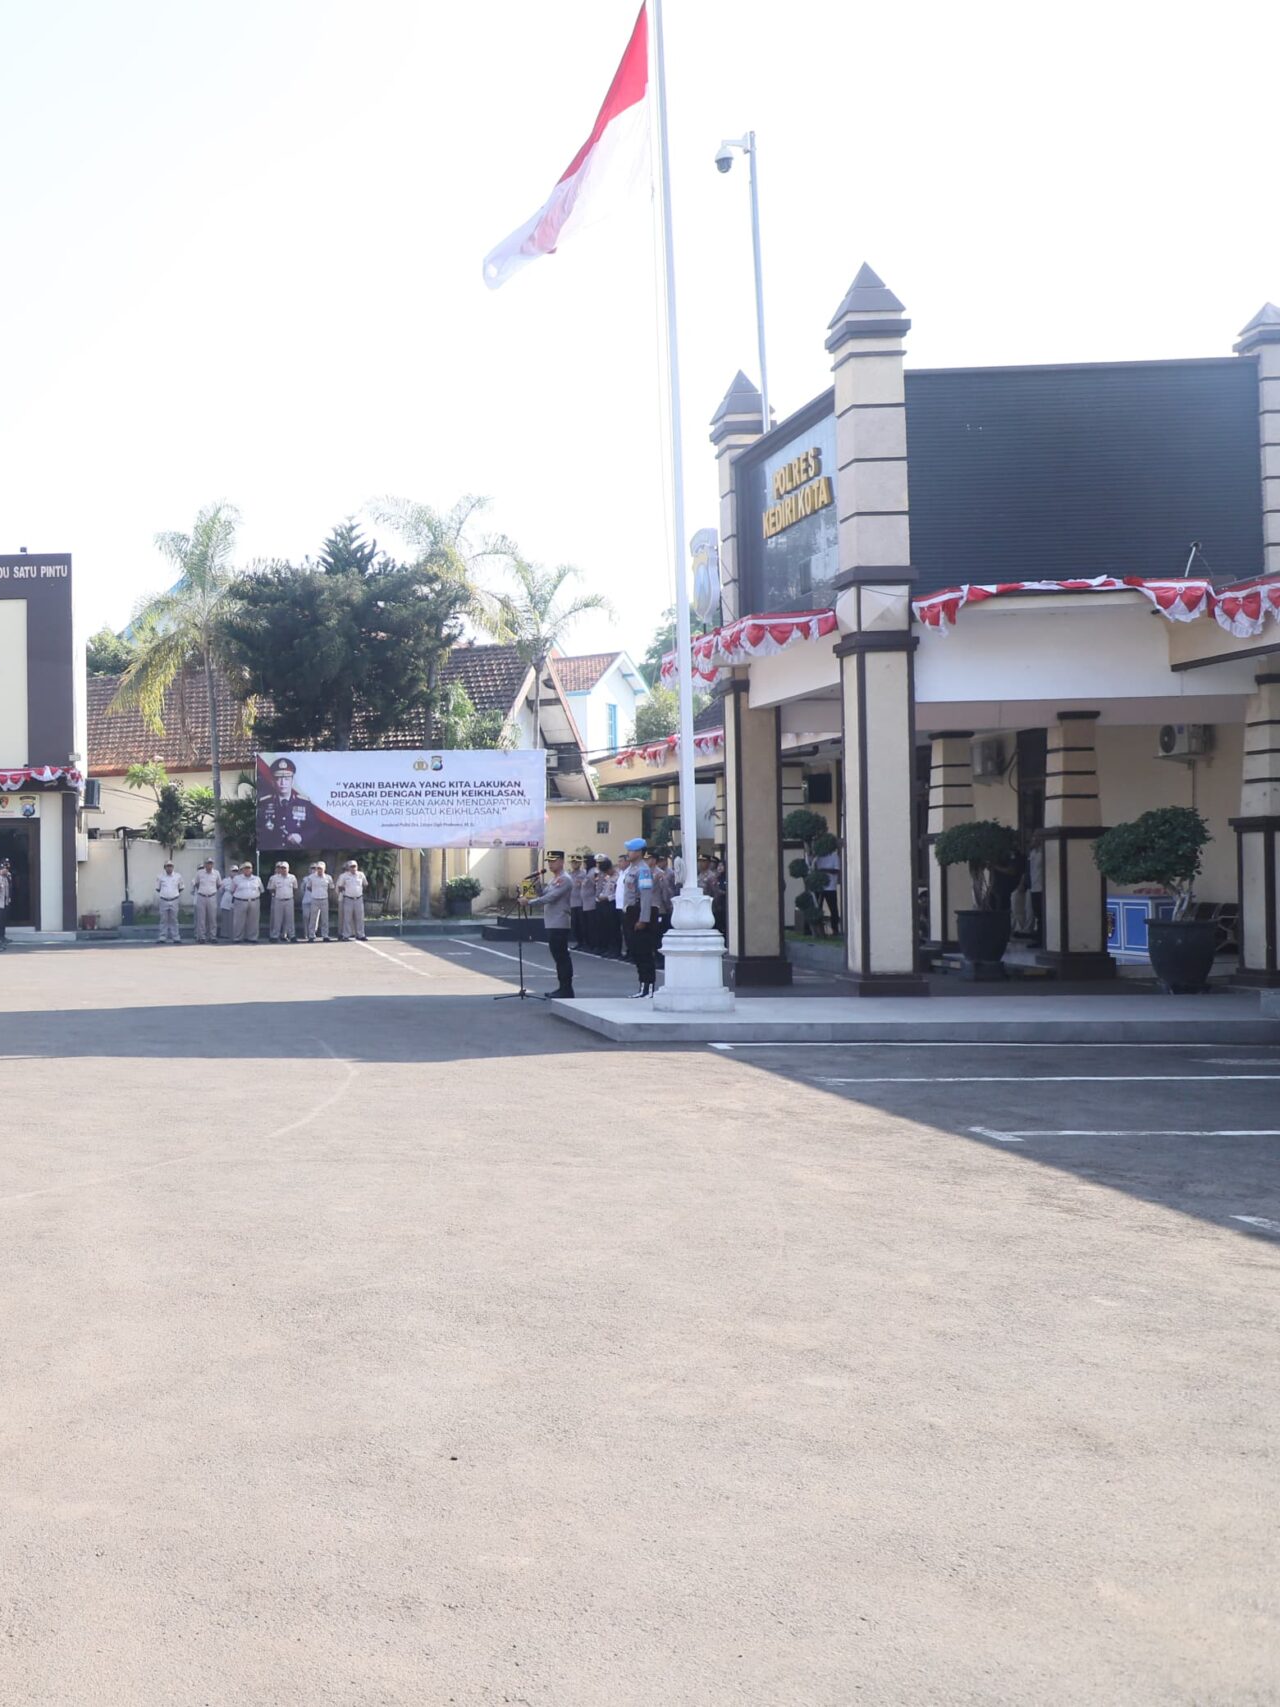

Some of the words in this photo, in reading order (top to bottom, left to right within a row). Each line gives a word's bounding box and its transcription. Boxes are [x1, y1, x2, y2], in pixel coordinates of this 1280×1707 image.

[773, 447, 820, 499] POLRES
[762, 492, 796, 539] KEDIRI
[797, 477, 832, 517] KOTA
[13, 565, 37, 579] SATU
[40, 564, 68, 578] PINTU
[342, 781, 375, 789] YAKINI
[377, 781, 417, 789] BAHWA
[419, 781, 446, 789] YANG
[448, 780, 471, 789] KITA
[473, 780, 521, 788] LAKUKAN
[330, 790, 377, 799] DIDASARI
[380, 790, 422, 798] DENGAN
[424, 790, 459, 798] PENUH
[326, 800, 354, 808] MAKA
[356, 799, 425, 807] REKAN-REKAN
[427, 799, 454, 807] AKAN
[456, 798, 531, 806] MENDAPATKAN
[351, 808, 378, 816] BUAH
[380, 808, 404, 816] DARI
[405, 807, 437, 816] SUATU
